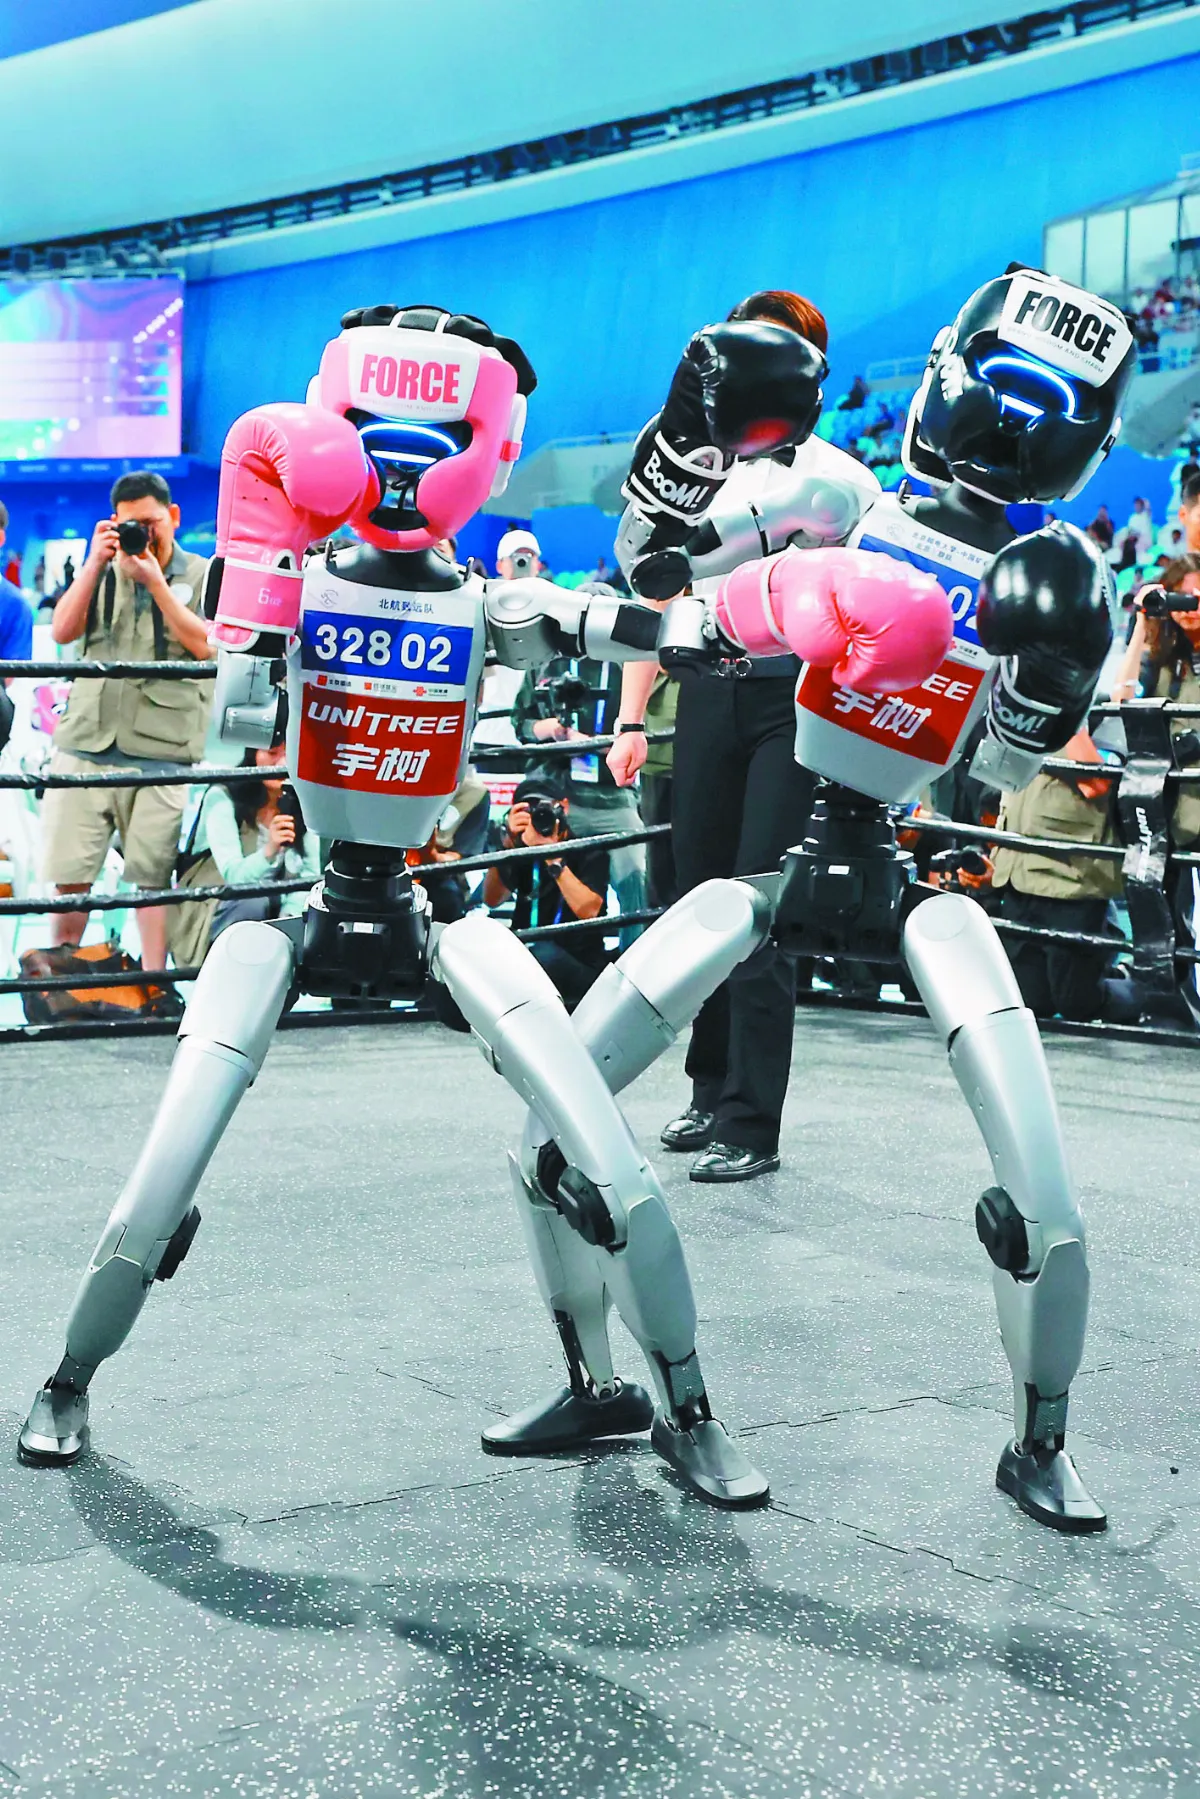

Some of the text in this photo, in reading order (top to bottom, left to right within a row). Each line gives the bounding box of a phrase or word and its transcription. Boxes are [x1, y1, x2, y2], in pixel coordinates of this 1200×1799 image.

[1014, 290, 1117, 363] FORCE
[360, 353, 461, 404] FORCE
[307, 701, 461, 736] UNITREE
[332, 743, 431, 783] 宇树
